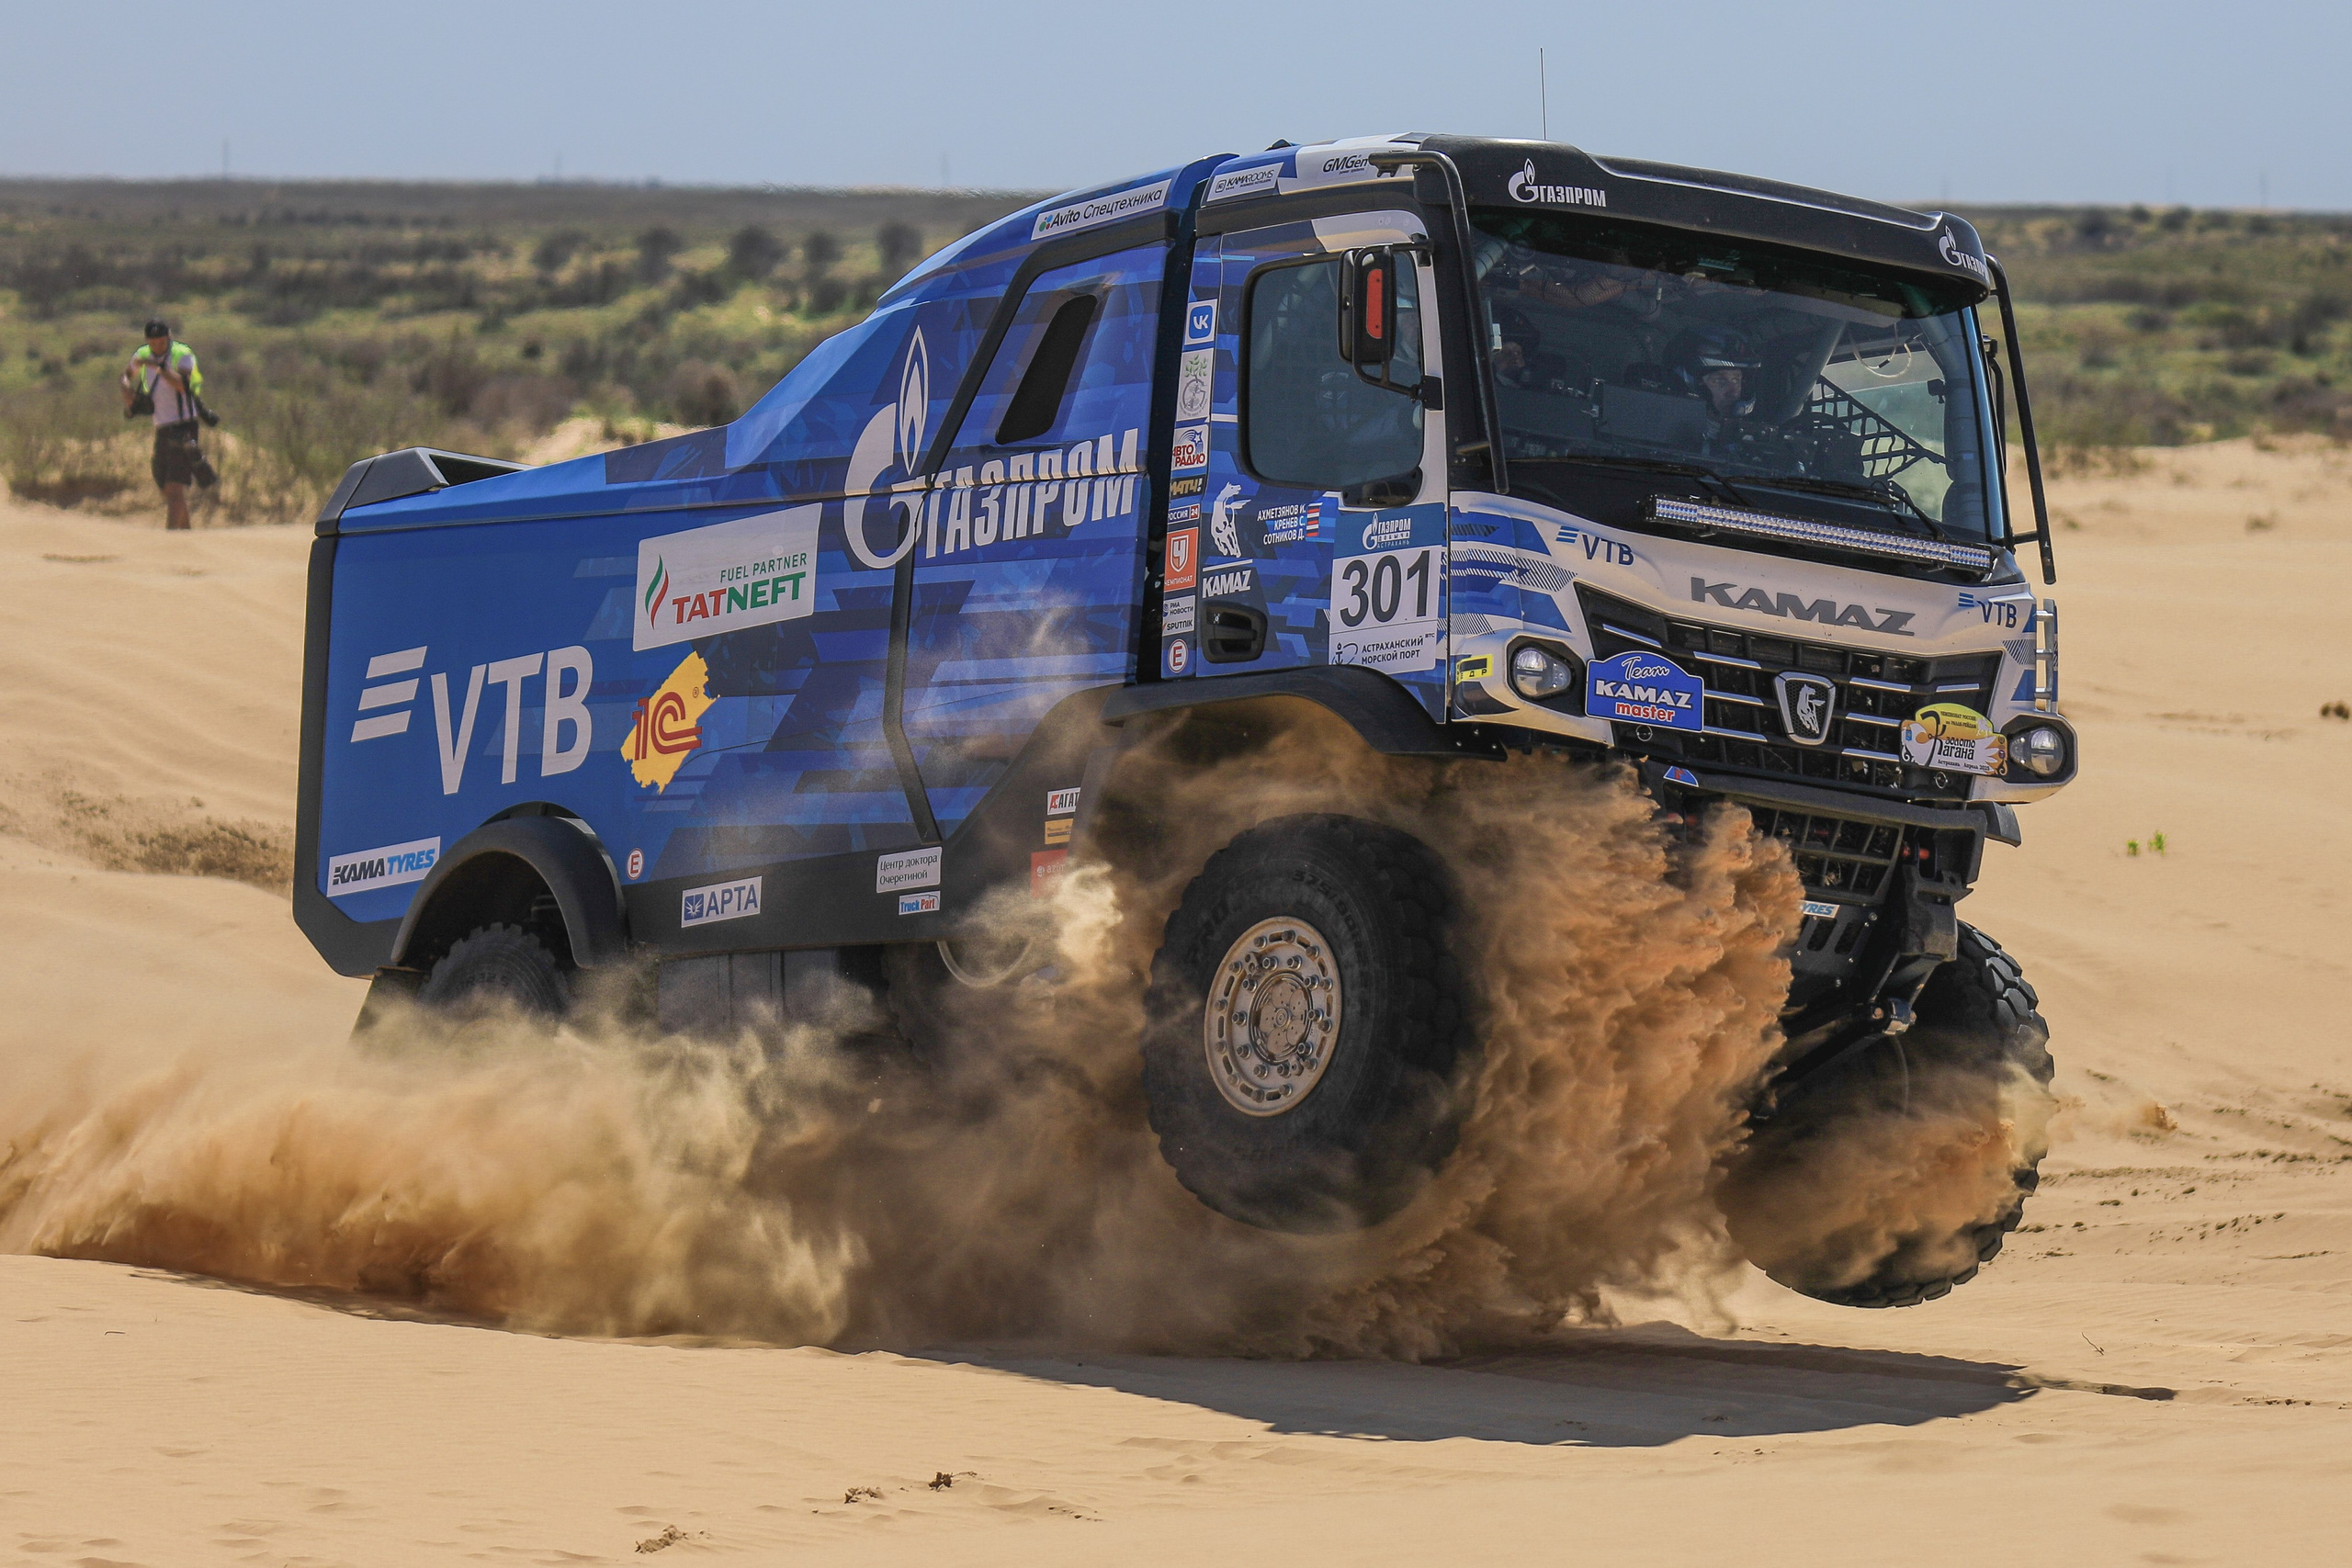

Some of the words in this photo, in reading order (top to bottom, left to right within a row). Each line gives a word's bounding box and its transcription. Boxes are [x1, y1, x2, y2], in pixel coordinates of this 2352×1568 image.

[1322, 154, 1368, 173] GMGen
[1539, 186, 1607, 208] ГАЗПРОМ
[1051, 209, 1080, 230] Avito
[1083, 188, 1162, 220] Спецтехника
[1193, 314, 1209, 330] VK
[1175, 453, 1205, 467] РАДИО
[924, 428, 1139, 559] ГАЗПРОМ
[1191, 507, 1198, 516] 24
[1257, 505, 1298, 522] АХМЕТЗЯНОВ
[1299, 503, 1306, 514] И.
[1273, 516, 1298, 531] КРЕНЕВ
[1298, 515, 1306, 526] С.
[1378, 517, 1411, 534] ГАЗПРОМ
[1263, 531, 1297, 545] СОТНИКОВ
[1297, 528, 1305, 541] Д.
[1377, 539, 1410, 548] АСТРАХАНЬ
[1582, 534, 1634, 566] VTB
[719, 565, 750, 584] FUEL
[752, 552, 808, 577] PARTNER
[1202, 570, 1251, 599] KAMAZ
[1340, 549, 1430, 627] 301
[672, 571, 808, 625] TATNEFT
[1690, 576, 1917, 637] KAMAZ
[1170, 606, 1194, 615] НОВОСТИ
[1976, 600, 2018, 629] VTB
[1362, 635, 1424, 653] АСТРАХАНСКИЙ
[1172, 645, 1182, 667] E
[1361, 650, 1398, 665] МОРСКОЙ
[1399, 649, 1420, 660] ПОРТ
[1621, 655, 1670, 681] Team
[1595, 680, 1693, 709] KAMAZ
[430, 645, 594, 795] VTB
[1615, 701, 1676, 723] master
[333, 856, 386, 887] KAMA
[386, 848, 435, 875] TYRES
[629, 852, 640, 874] E
[879, 858, 904, 872] Центр
[905, 854, 938, 869] доктора
[879, 869, 929, 886] Очеретиной
[899, 898, 920, 913] Truck
[920, 897, 935, 910] Part
[1802, 902, 1835, 915] YRES
